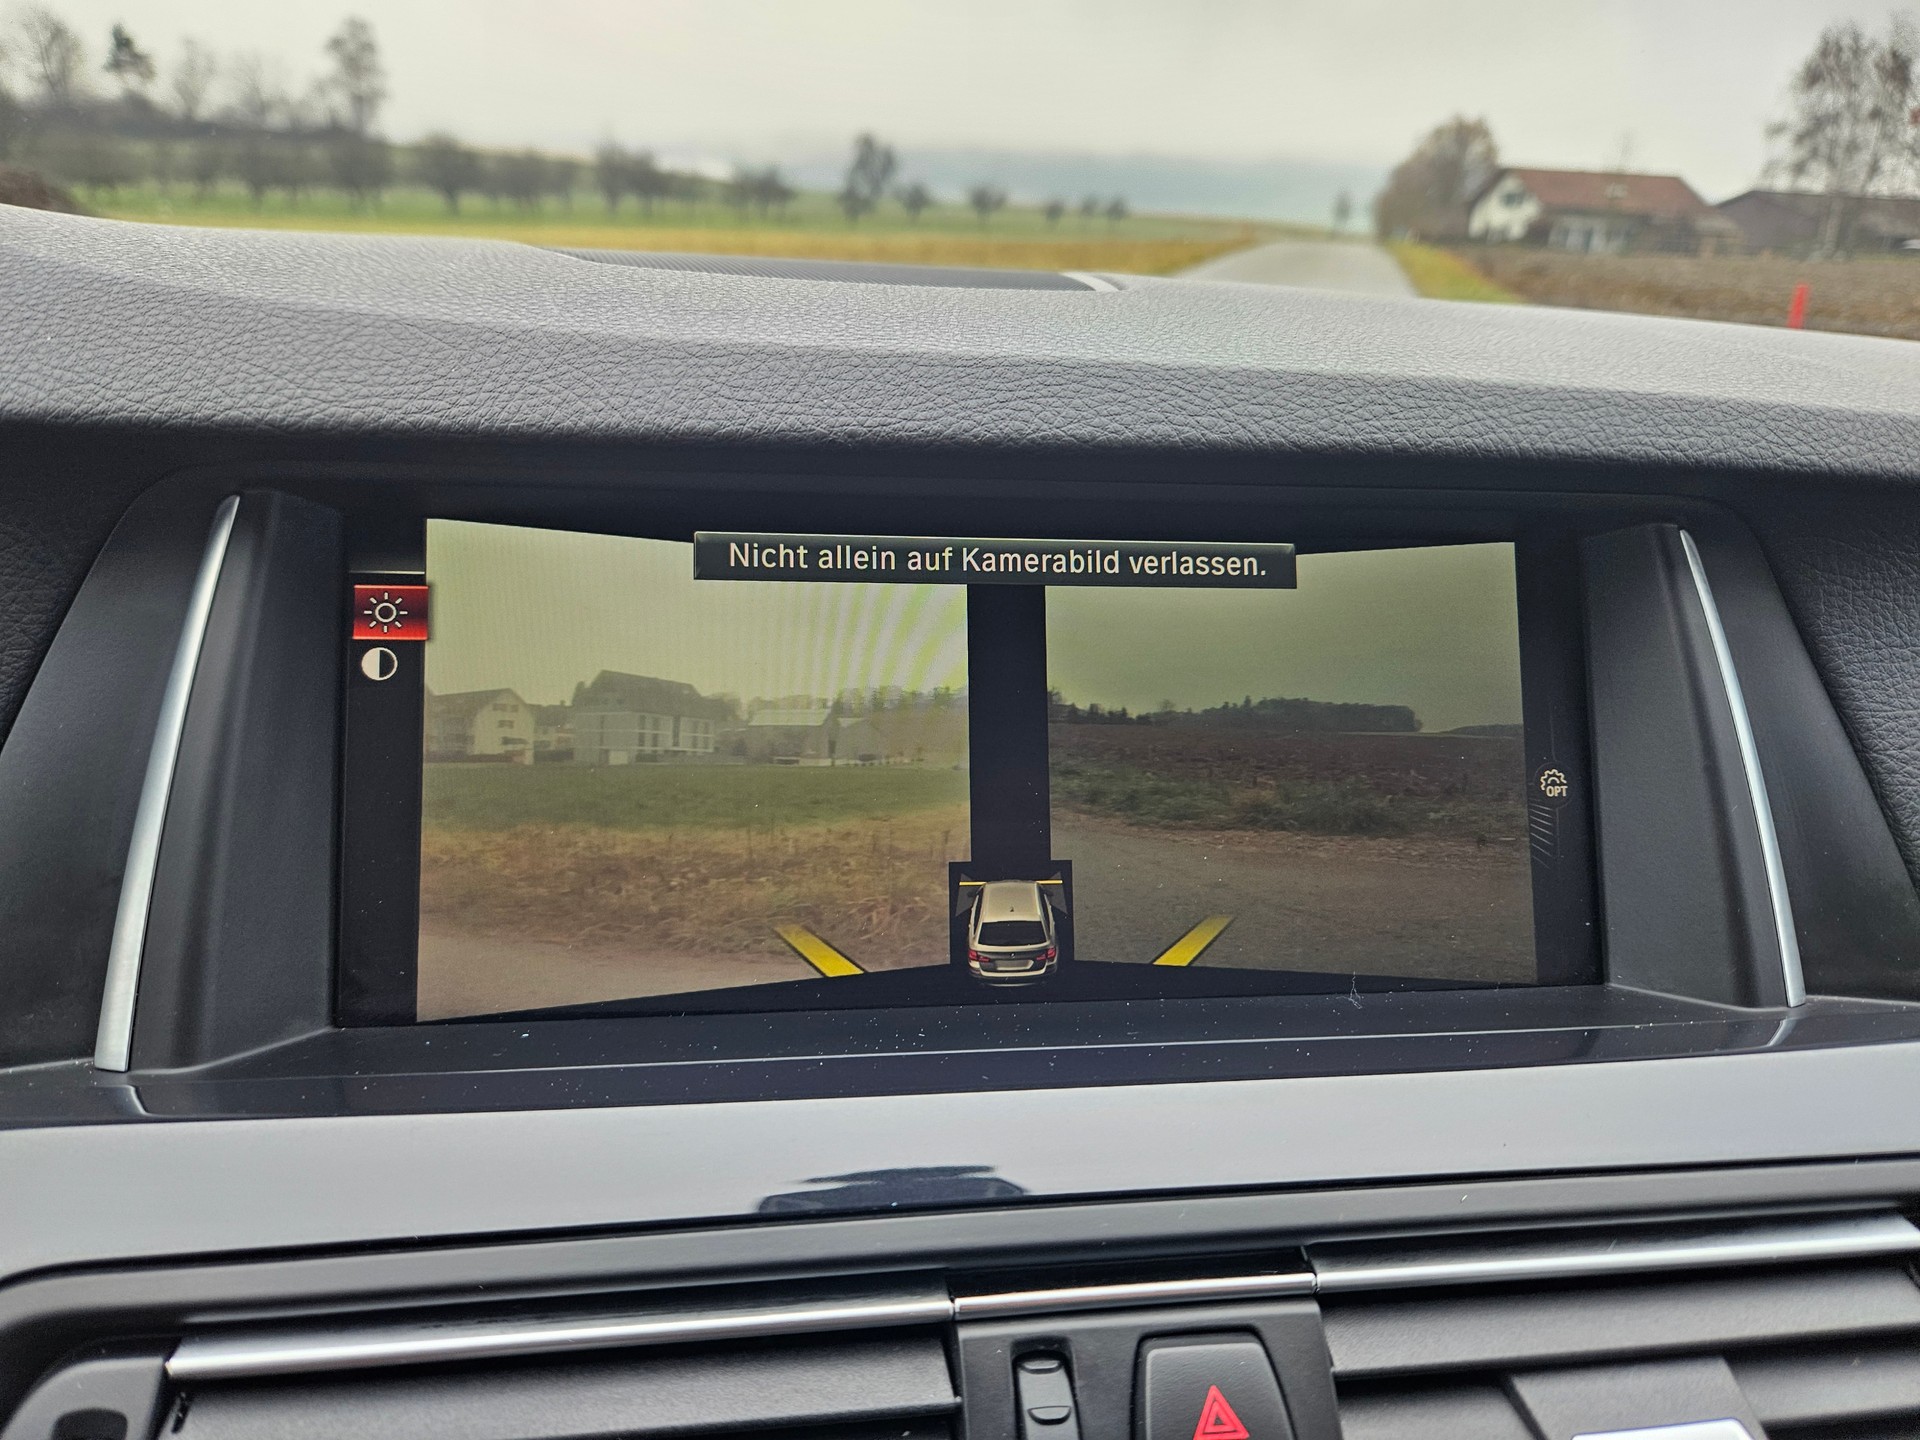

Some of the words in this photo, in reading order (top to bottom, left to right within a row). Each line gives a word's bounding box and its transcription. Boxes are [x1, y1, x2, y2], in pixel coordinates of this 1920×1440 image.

[730, 542, 809, 569] Nicht
[818, 544, 896, 571] allein
[907, 546, 953, 572] auf
[962, 547, 1120, 575] Kamerabild
[1128, 551, 1266, 577] verlassen.
[1546, 785, 1568, 797] OPT
